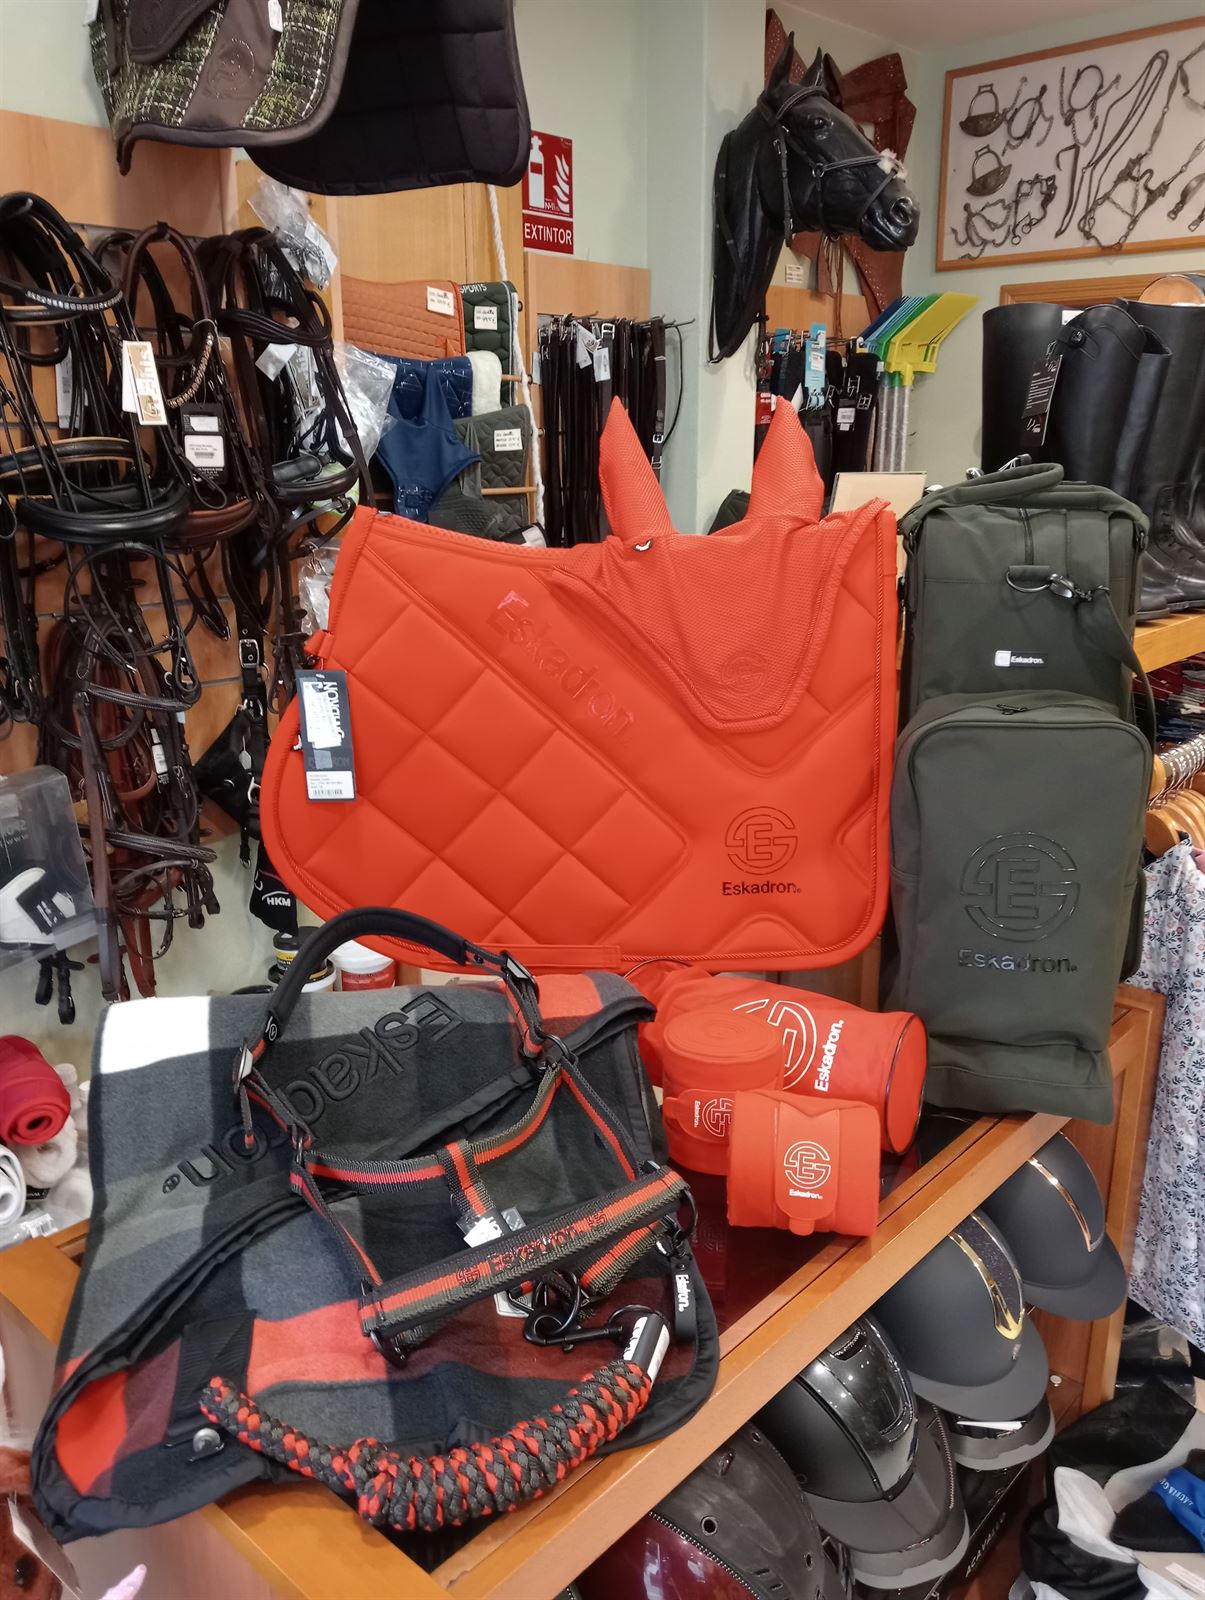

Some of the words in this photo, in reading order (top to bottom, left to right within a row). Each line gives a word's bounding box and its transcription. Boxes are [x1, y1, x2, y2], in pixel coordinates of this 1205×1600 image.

[524, 222, 573, 246] EXTINTOR
[460, 283, 488, 294] SPORTS
[1010, 655, 1043, 664] Eskadron
[722, 881, 797, 896] Eskadron
[266, 897, 291, 907] HKM
[959, 949, 1070, 973] Eskadron
[814, 1022, 843, 1092] Eskadron
